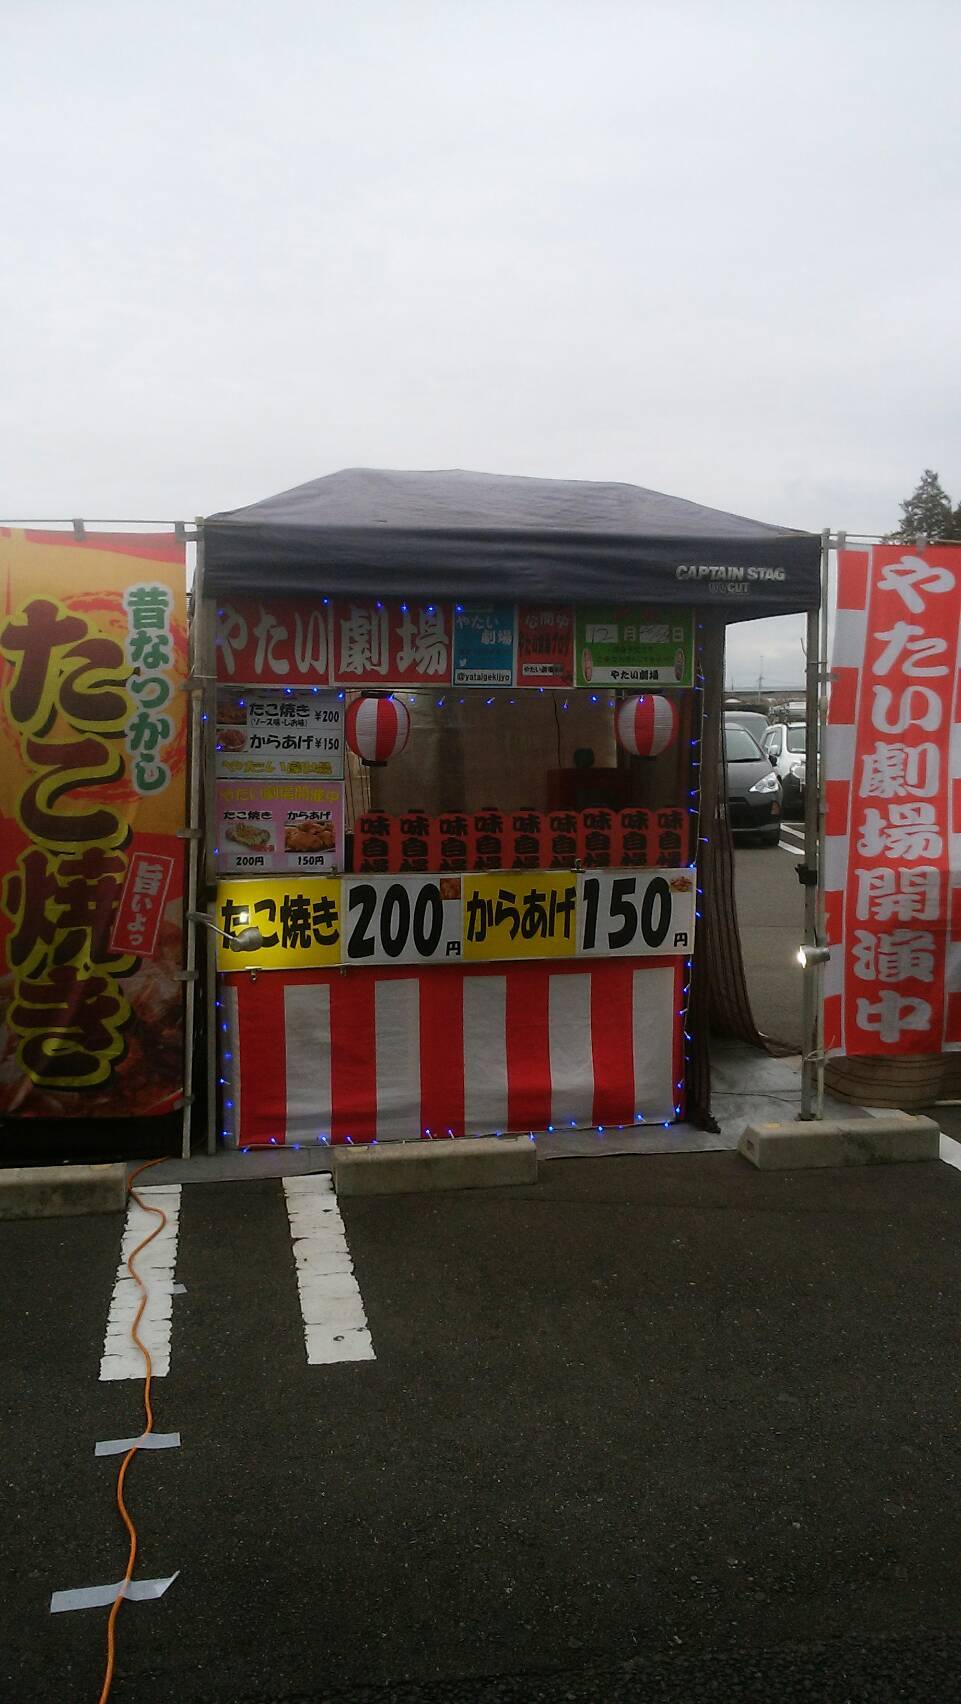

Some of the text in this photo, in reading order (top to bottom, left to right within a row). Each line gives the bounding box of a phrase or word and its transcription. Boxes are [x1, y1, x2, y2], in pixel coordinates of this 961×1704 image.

[675, 565, 785, 581] CAPTAIN STAG
[220, 603, 450, 675] やたい劇場
[126, 585, 172, 793] 昔なつかし
[249, 703, 340, 723] たこ焼き ¥200
[250, 734, 340, 750] からあげ ¥150
[223, 810, 331, 820] たこ焼き からあげ
[851, 555, 956, 1043] やたい劇場開演中
[0, 596, 130, 1082] たこ焼き
[236, 856, 324, 866] 200円 150円
[221, 876, 688, 959] たこ焼き 200円 からあげ 150円
